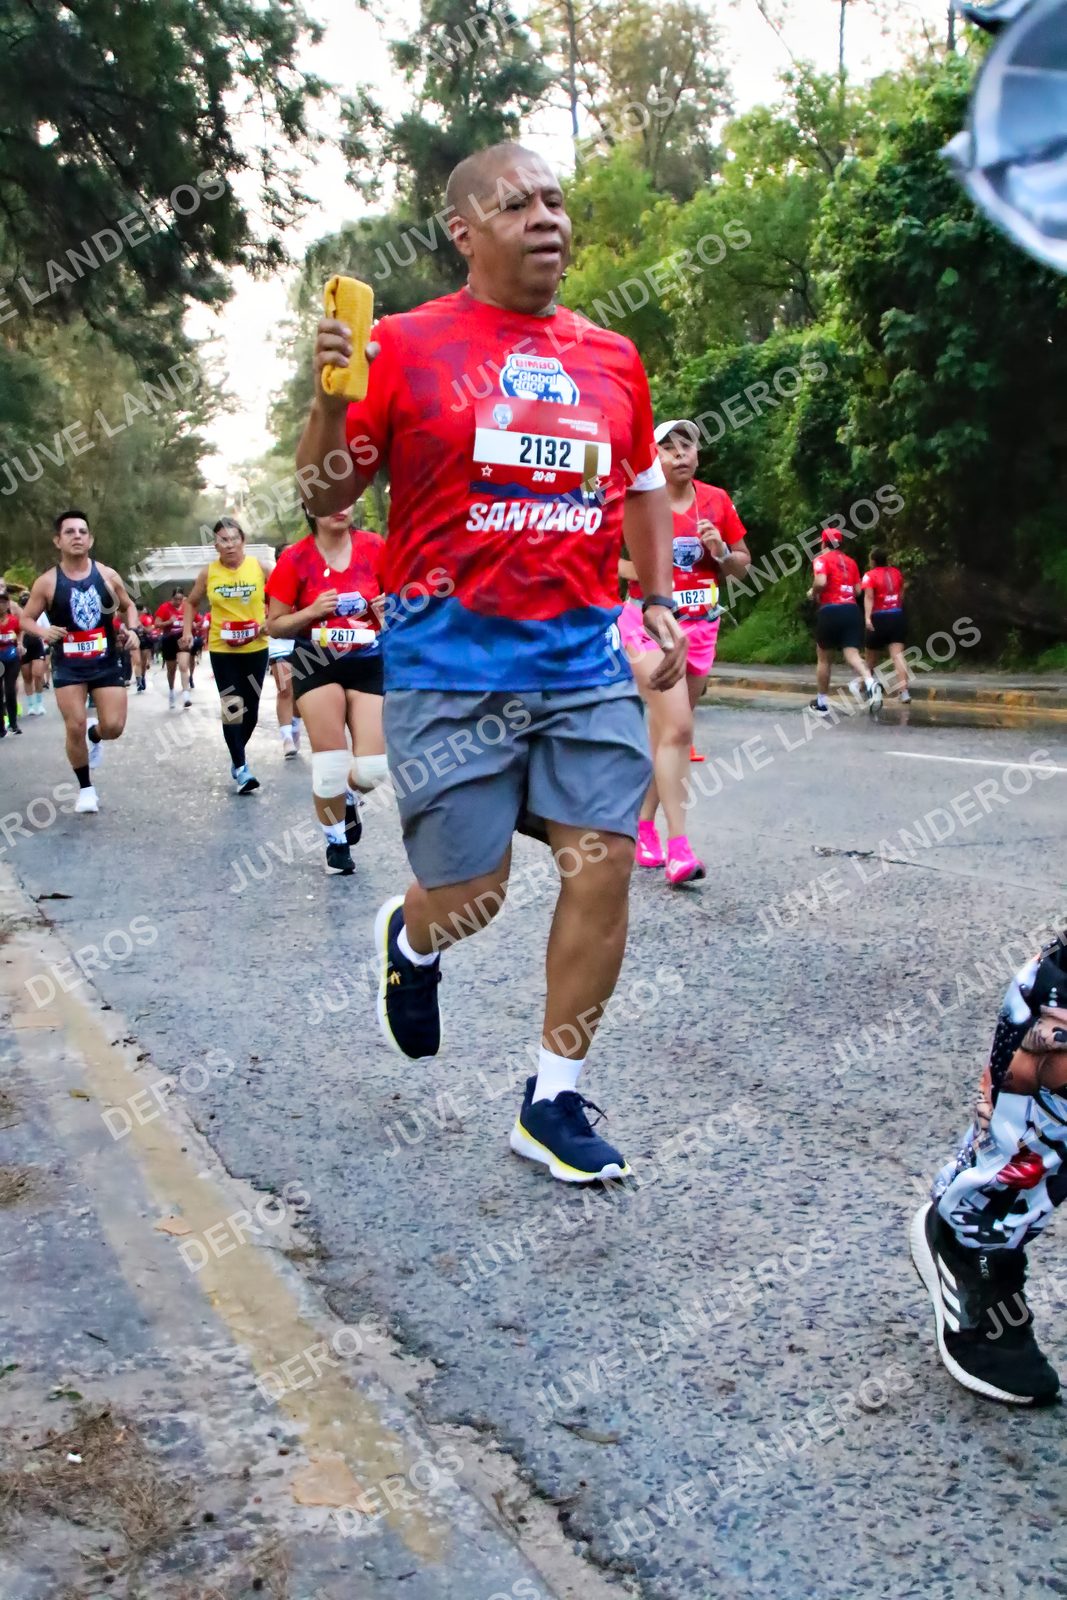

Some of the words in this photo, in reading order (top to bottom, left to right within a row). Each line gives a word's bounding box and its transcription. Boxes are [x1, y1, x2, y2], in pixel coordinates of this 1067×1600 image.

[515, 360, 556, 371] BIMBO
[518, 371, 558, 385] Global
[513, 378, 545, 393] Race
[519, 435, 572, 469] 2132
[465, 501, 603, 536] SANTIAGO
[680, 589, 706, 605] 1623
[330, 629, 356, 642] 2617
[77, 641, 95, 651] 1637
